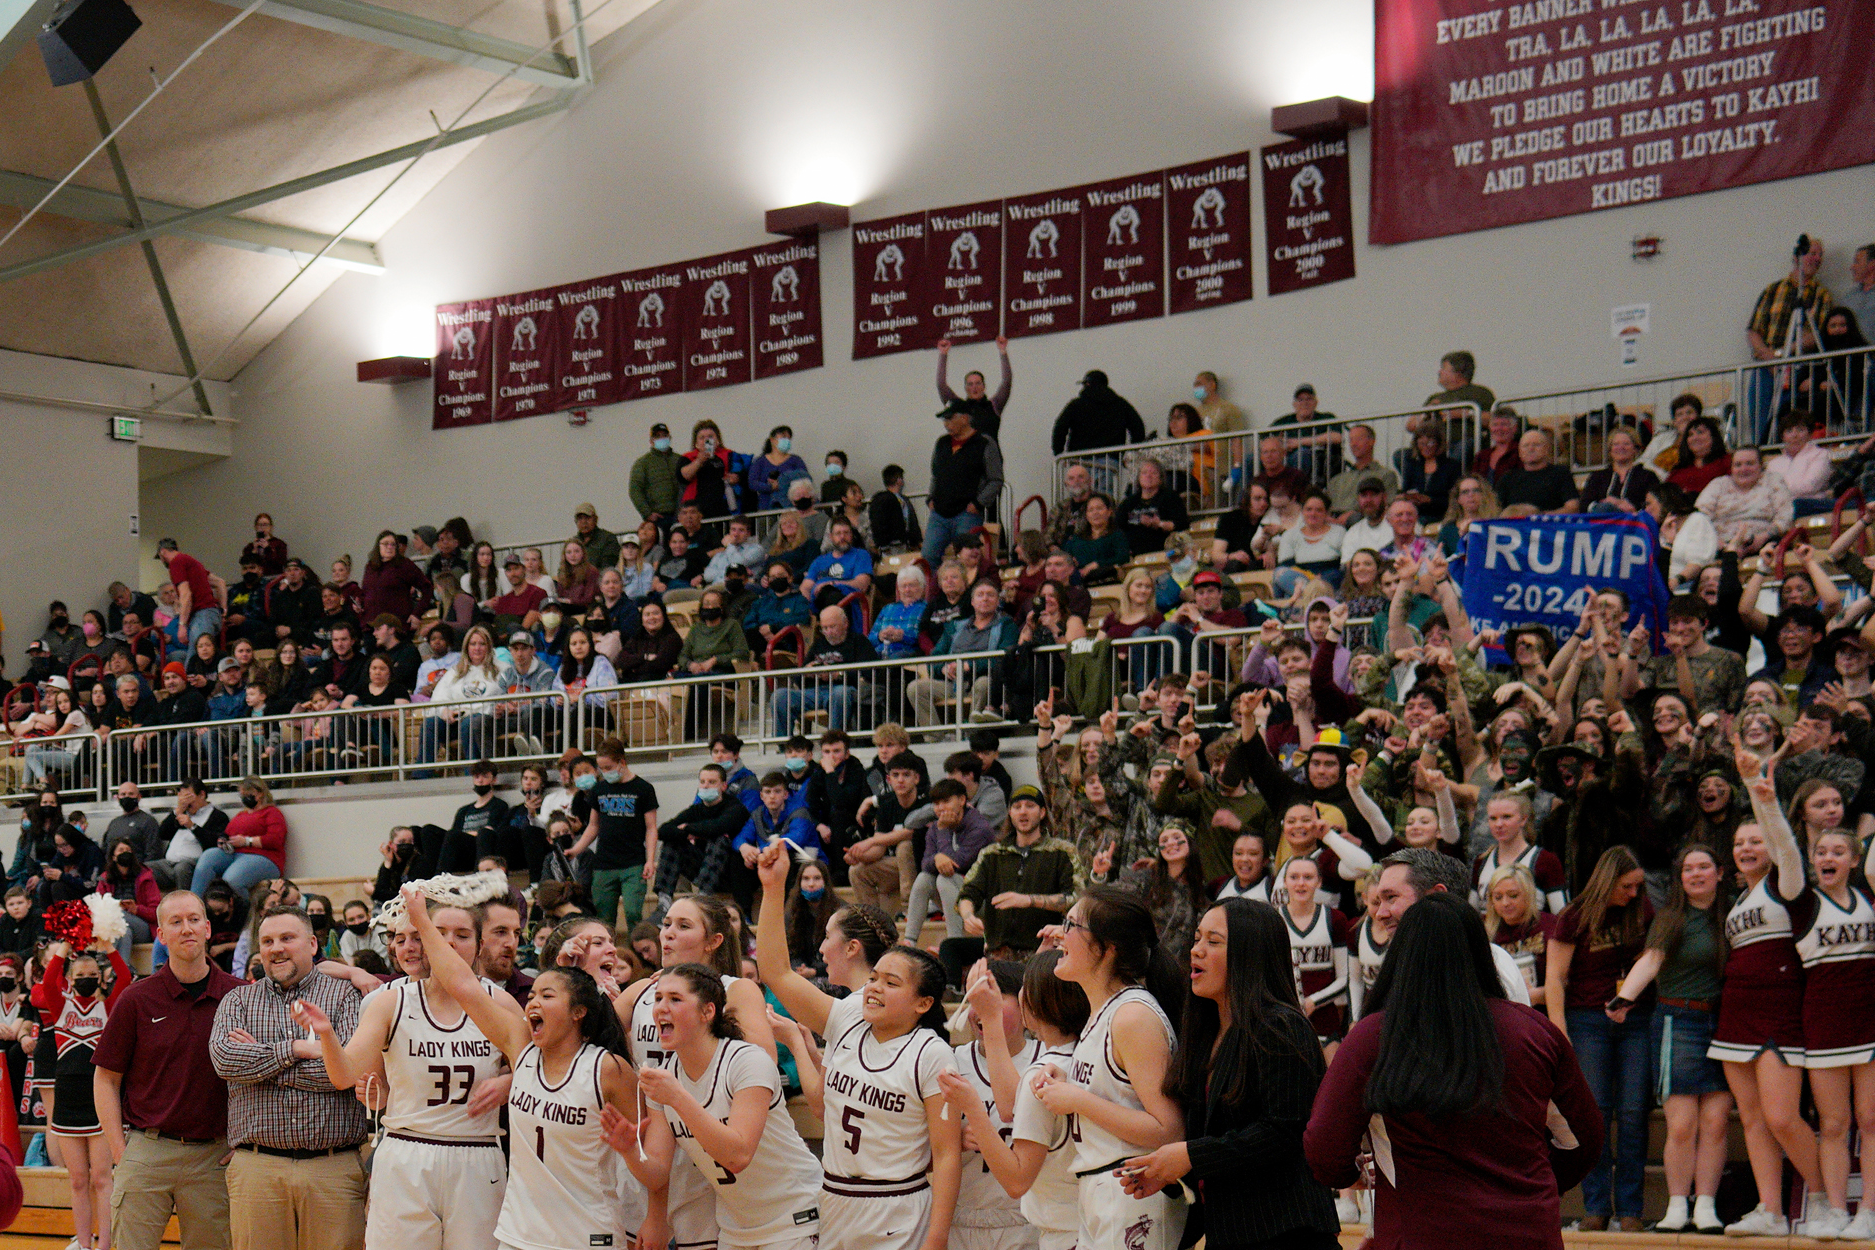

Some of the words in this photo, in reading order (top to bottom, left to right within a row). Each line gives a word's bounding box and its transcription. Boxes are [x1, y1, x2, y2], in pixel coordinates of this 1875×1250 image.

[1436, 9, 1503, 45] EVERY
[1508, 0, 1593, 29] BANNER
[1449, 66, 1535, 105] MAROON
[1540, 56, 1585, 88] AND
[1591, 40, 1662, 76] WHITE
[1667, 30, 1714, 62] ARE
[1719, 7, 1826, 50] FIGHTING
[1490, 103, 1517, 129] TO
[1523, 89, 1586, 123] BRING
[1592, 76, 1653, 110] HOME
[1658, 72, 1675, 97] A
[1682, 51, 1776, 92] VICTORY
[1452, 141, 1484, 167] WE
[1490, 126, 1566, 161] PLEDGE
[1572, 117, 1613, 146] OUR
[1620, 100, 1706, 137] HEARTS
[1711, 92, 1740, 119] TO
[1747, 77, 1820, 113] KAYHI
[1264, 138, 1346, 171] Wrestling
[1482, 166, 1525, 194] AND
[1532, 148, 1625, 186] FOREVER
[1633, 139, 1674, 168] OUR
[1681, 119, 1781, 159] LOYALTY.
[1591, 175, 1662, 209] KINGS!
[1286, 210, 1330, 230] Region
[753, 245, 817, 267] Wrestling
[1274, 236, 1345, 261] Champions
[769, 310, 804, 326] Region
[759, 333, 816, 353] Champions
[1725, 906, 1766, 937] AYHI
[63, 1011, 103, 1031] Bears
[409, 1039, 444, 1057] LADY
[451, 1040, 491, 1057] KINGS
[427, 1065, 475, 1106] 33
[827, 1068, 859, 1097] LADY
[858, 1083, 906, 1113] KINGS
[510, 1087, 541, 1115] LADY
[542, 1101, 587, 1126] KINGS
[535, 1126, 545, 1163] 1
[842, 1105, 865, 1155] 5
